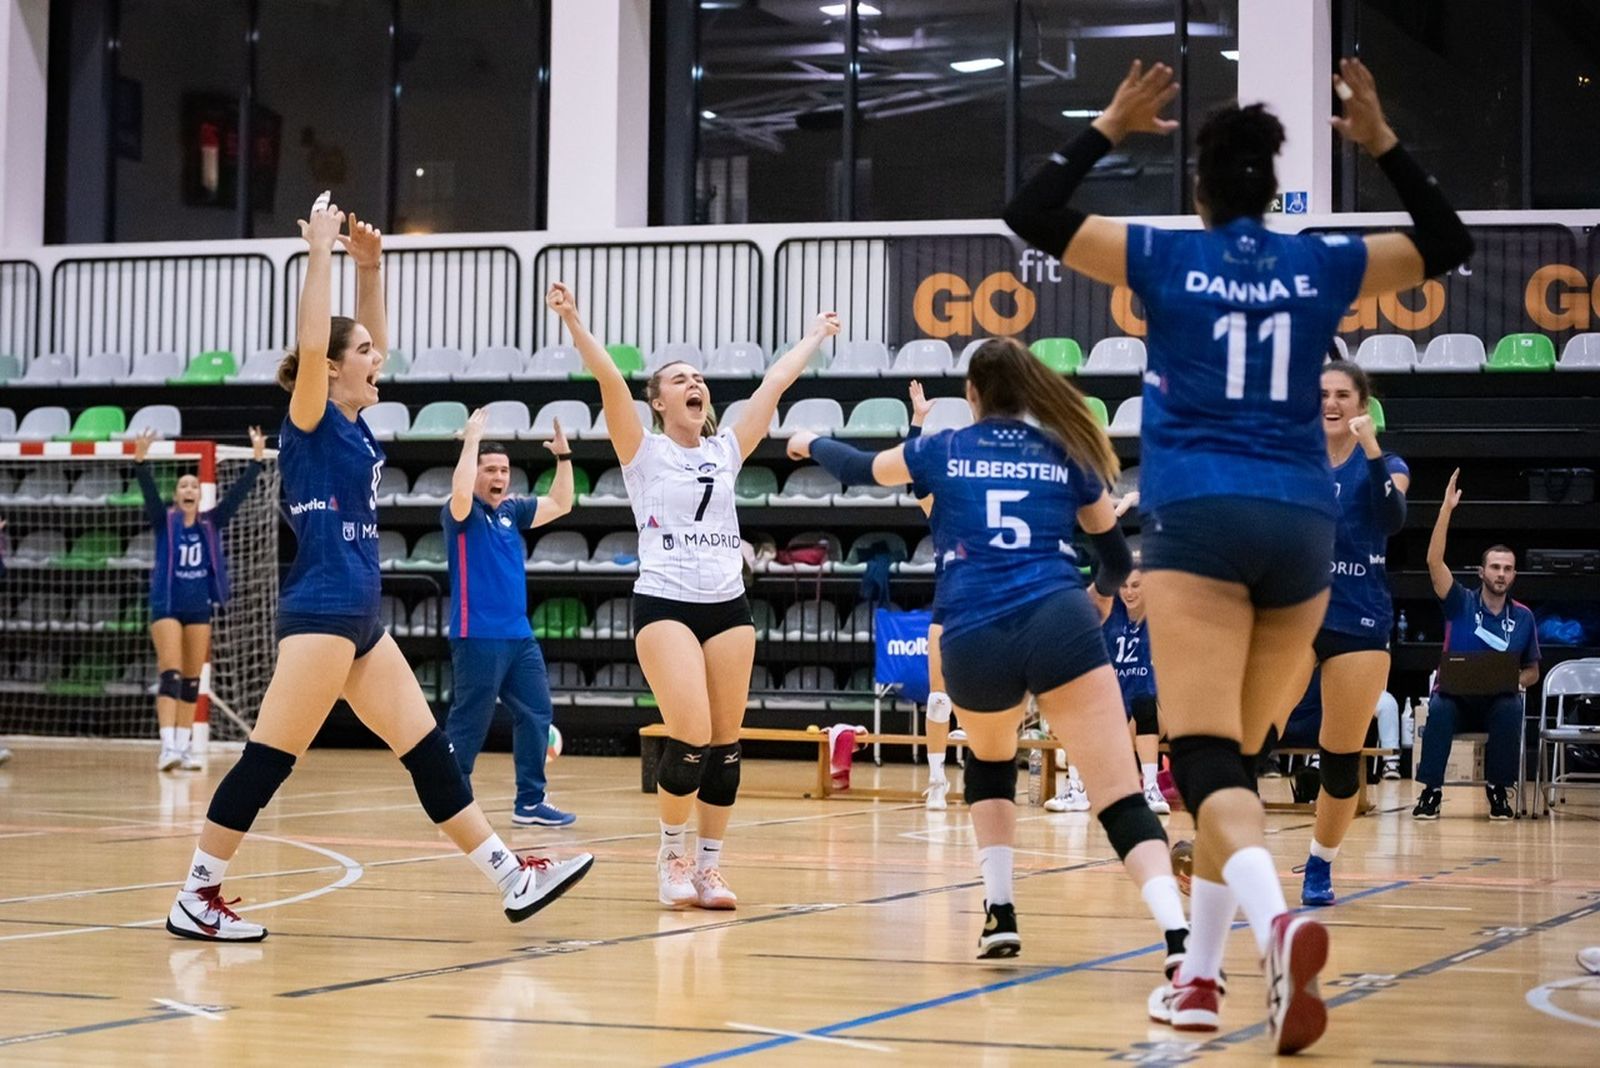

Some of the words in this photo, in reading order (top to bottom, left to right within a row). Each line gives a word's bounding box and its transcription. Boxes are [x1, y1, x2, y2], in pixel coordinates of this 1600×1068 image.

[1019, 249, 1062, 283] fit
[1185, 270, 1290, 303] DANNA
[1293, 274, 1318, 297] E.
[1524, 263, 1600, 332] G
[913, 271, 1037, 338] GO
[1213, 312, 1292, 401] 11
[946, 459, 1069, 484] SILBERSTEIN
[694, 476, 715, 522] 7
[986, 489, 1032, 550] 5
[178, 542, 202, 567] 10
[684, 533, 741, 549] MADRID
[1115, 635, 1140, 663] 12
